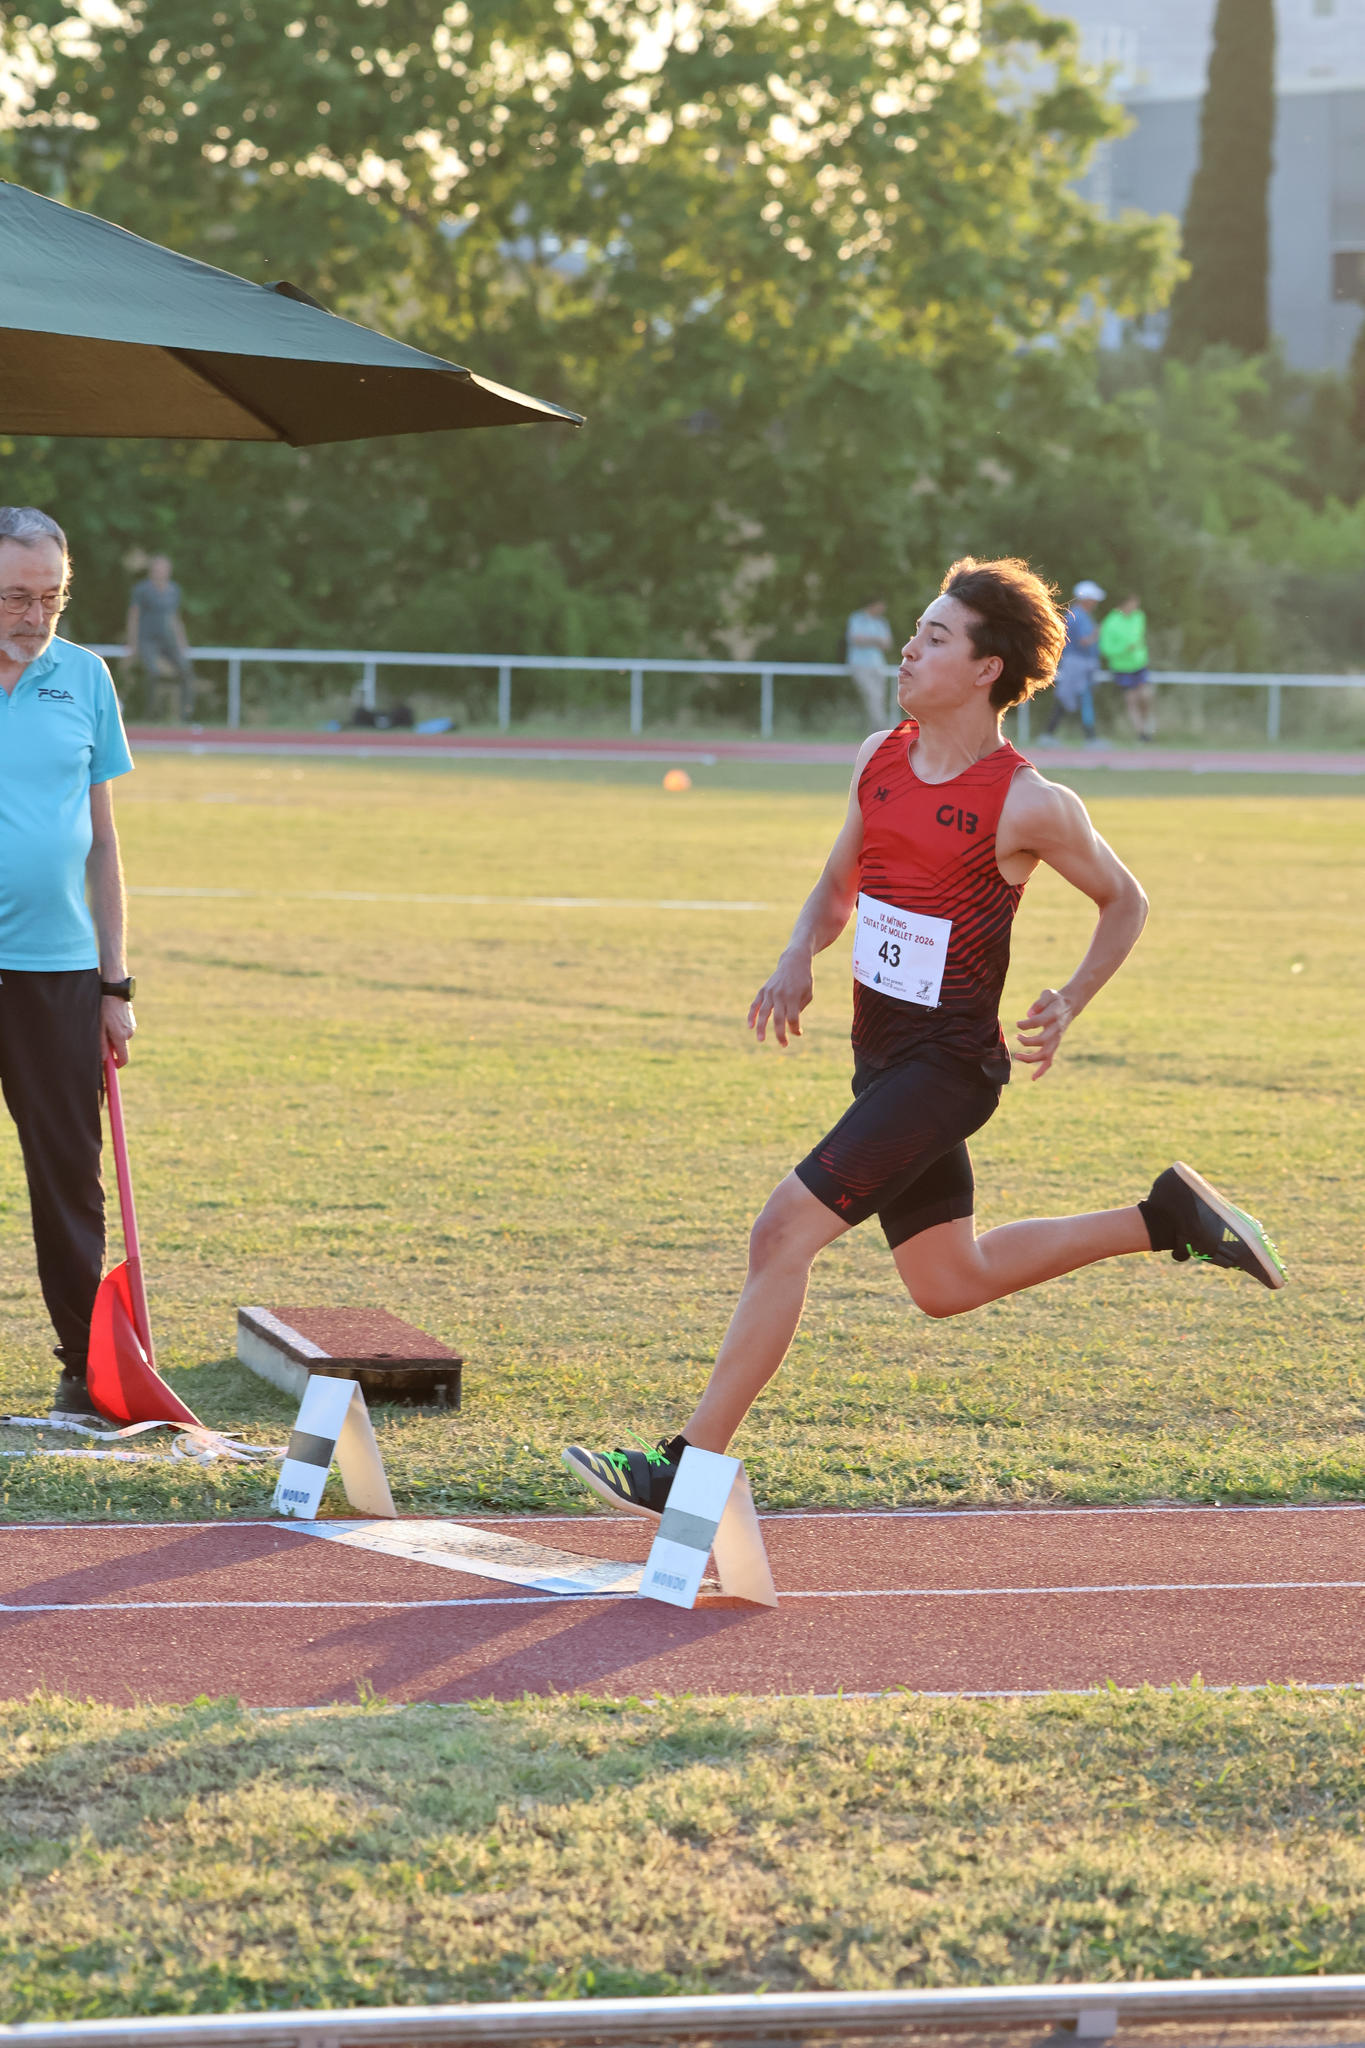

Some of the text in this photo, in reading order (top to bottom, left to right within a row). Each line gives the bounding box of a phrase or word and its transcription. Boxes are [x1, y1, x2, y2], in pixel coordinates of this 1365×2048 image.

[38, 688, 74, 700] FCA
[863, 915, 935, 947] CIUTAT DE MOLLET 2026
[878, 940, 901, 968] 43
[282, 1488, 311, 1504] MONDO
[652, 1570, 688, 1591] MONDO
